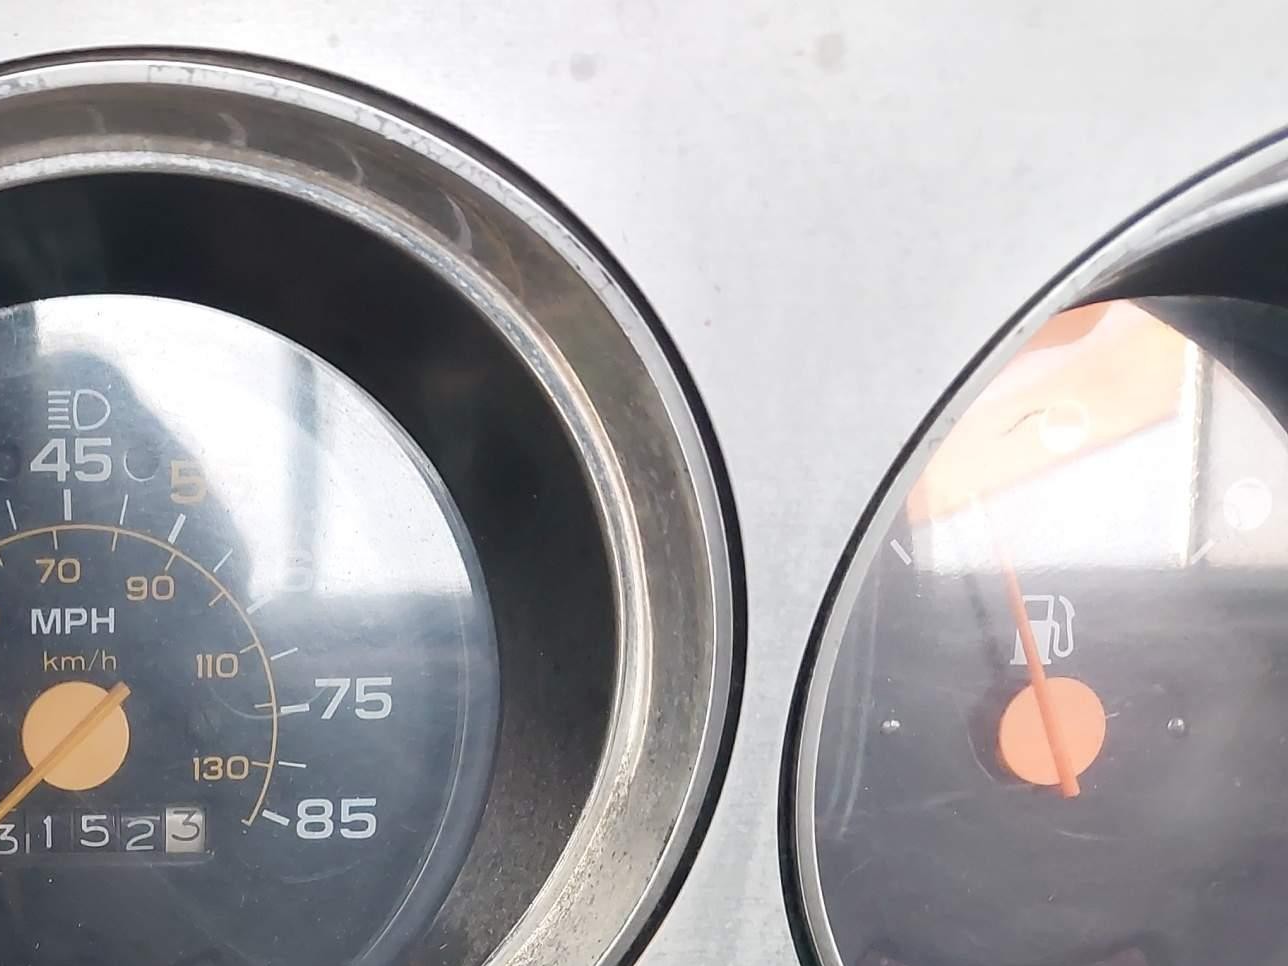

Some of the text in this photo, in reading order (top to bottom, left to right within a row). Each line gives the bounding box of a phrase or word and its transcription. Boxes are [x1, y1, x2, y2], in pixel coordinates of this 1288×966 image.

[30, 437, 112, 482] 45
[35, 558, 81, 584] 70
[125, 576, 175, 602] 90
[30, 607, 116, 635] MPH
[42, 650, 118, 673] km/h
[196, 653, 239, 679] 110
[314, 676, 393, 720] 75
[192, 755, 250, 782] 130
[295, 797, 378, 840] 85
